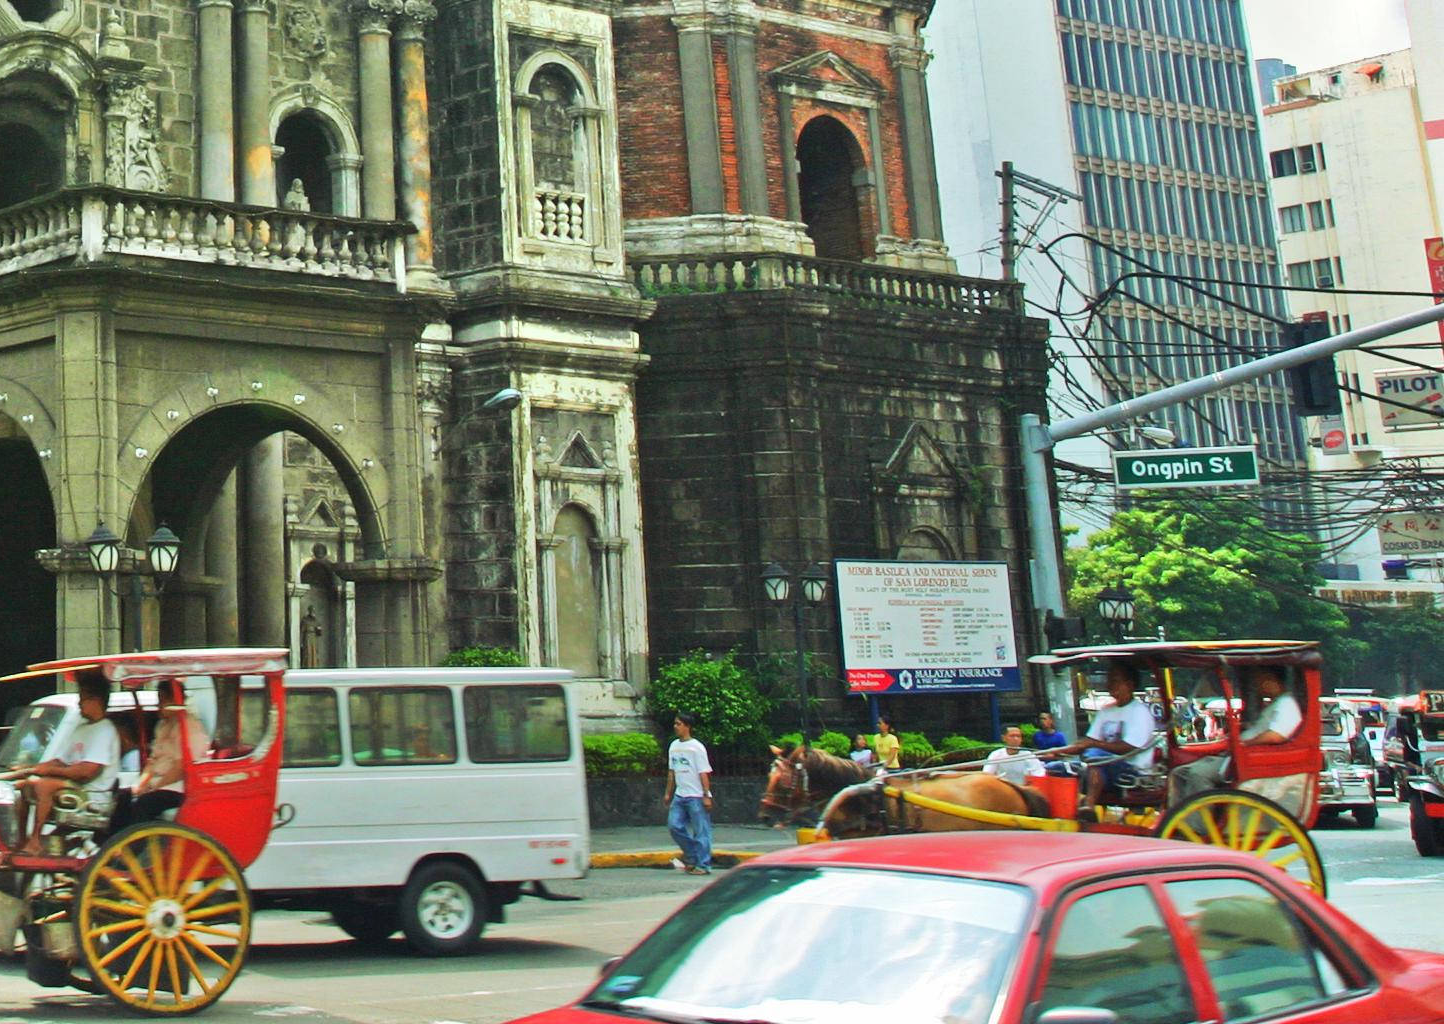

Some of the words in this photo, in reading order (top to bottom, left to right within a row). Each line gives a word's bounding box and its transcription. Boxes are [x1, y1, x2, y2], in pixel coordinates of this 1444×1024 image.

[1378, 376, 1440, 394] PILOT
[1132, 458, 1203, 480] Ongpin
[1209, 456, 1234, 473] St
[1383, 541, 1419, 551] COSMOS
[848, 567, 873, 576] MINOR
[875, 567, 910, 577] BASILICA
[913, 568, 929, 577] AND
[932, 568, 969, 577] NATIONAL
[883, 578, 893, 587] OF
[896, 578, 912, 587] SAN
[913, 578, 949, 587] LORENZO
[914, 669, 956, 678] MALAYAN
[959, 668, 1003, 678] INSURANCE
